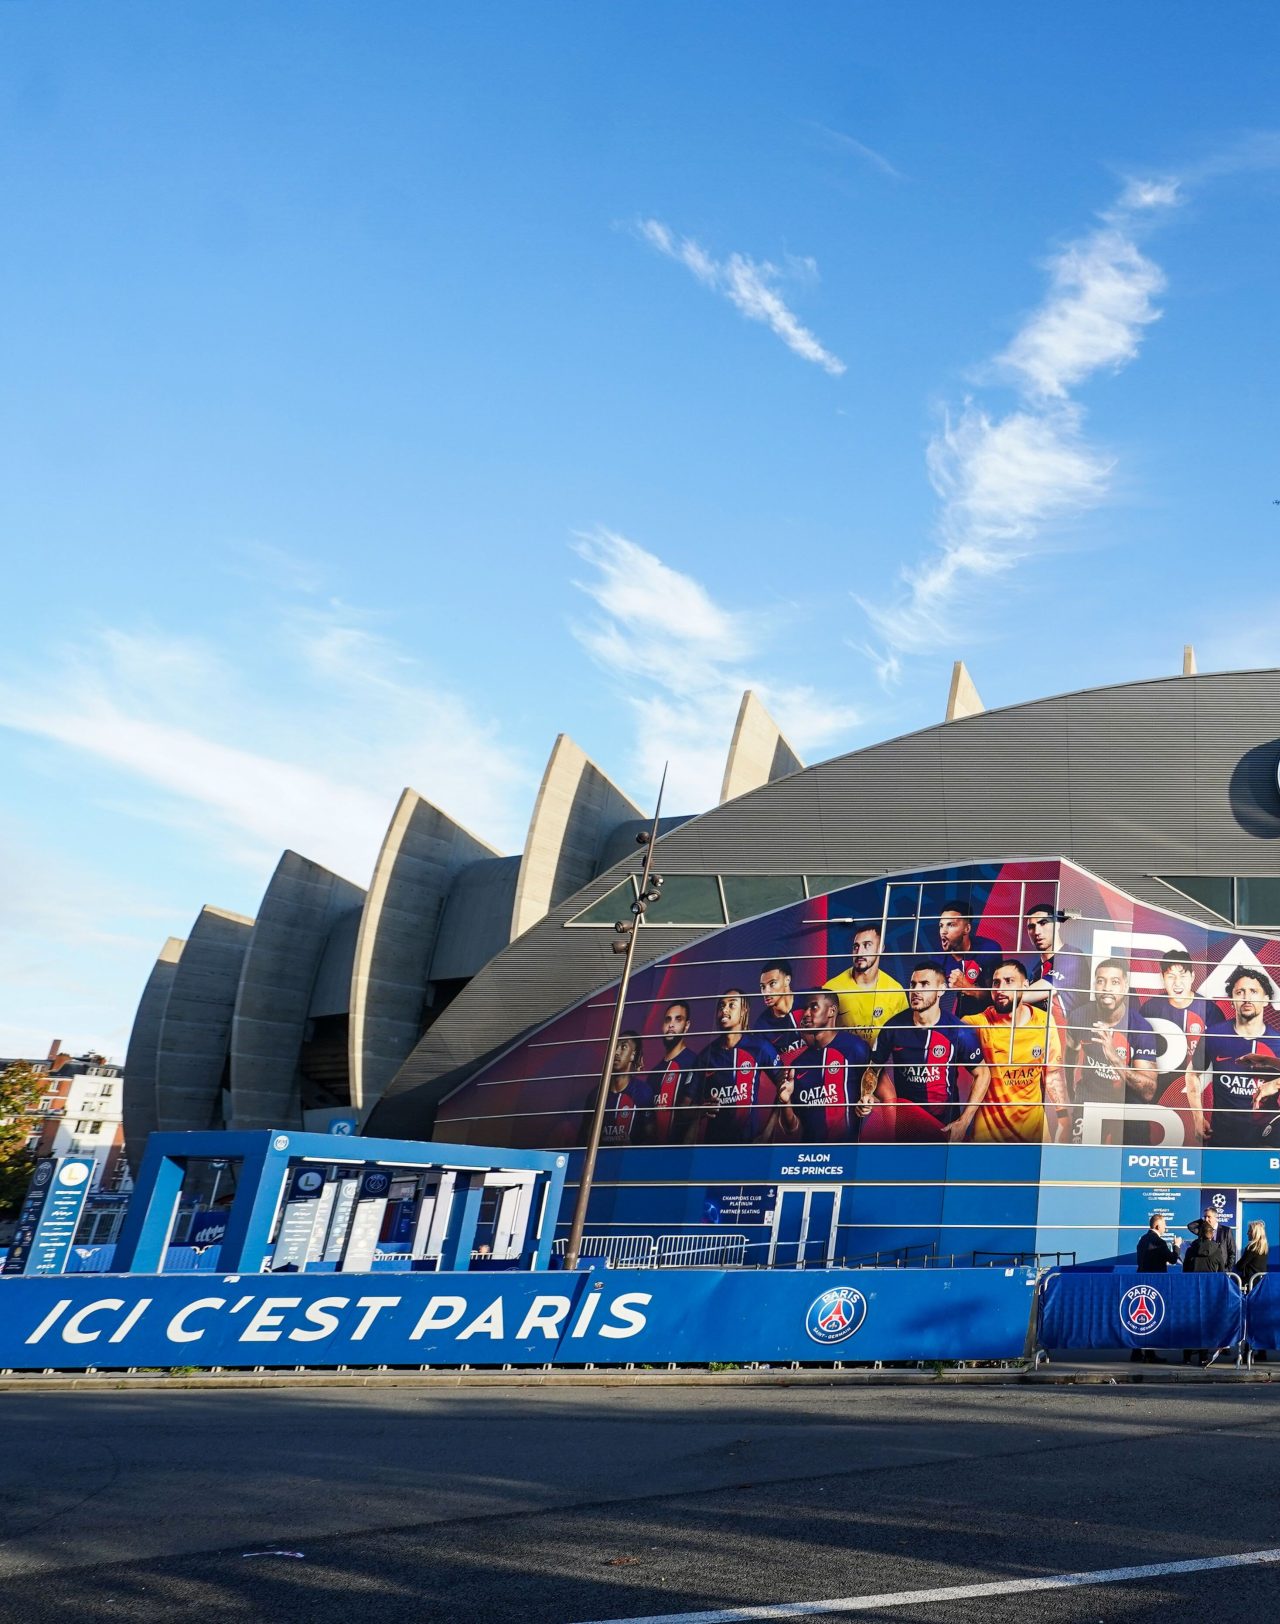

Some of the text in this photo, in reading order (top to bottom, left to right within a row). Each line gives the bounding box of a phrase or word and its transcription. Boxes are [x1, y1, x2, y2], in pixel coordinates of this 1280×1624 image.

[711, 1083, 747, 1097] QATAR
[800, 1084, 837, 1101] QATAR
[798, 1154, 830, 1162] SALON
[781, 1167, 844, 1175] DES PRINCES
[1129, 1155, 1195, 1175] PORTE L
[1148, 1168, 1178, 1178] GATE
[303, 1176, 315, 1187] L
[822, 1289, 860, 1304] PARIS
[1127, 1287, 1158, 1300] PARIS
[25, 1292, 653, 1344] ICI C'EST PARIS
